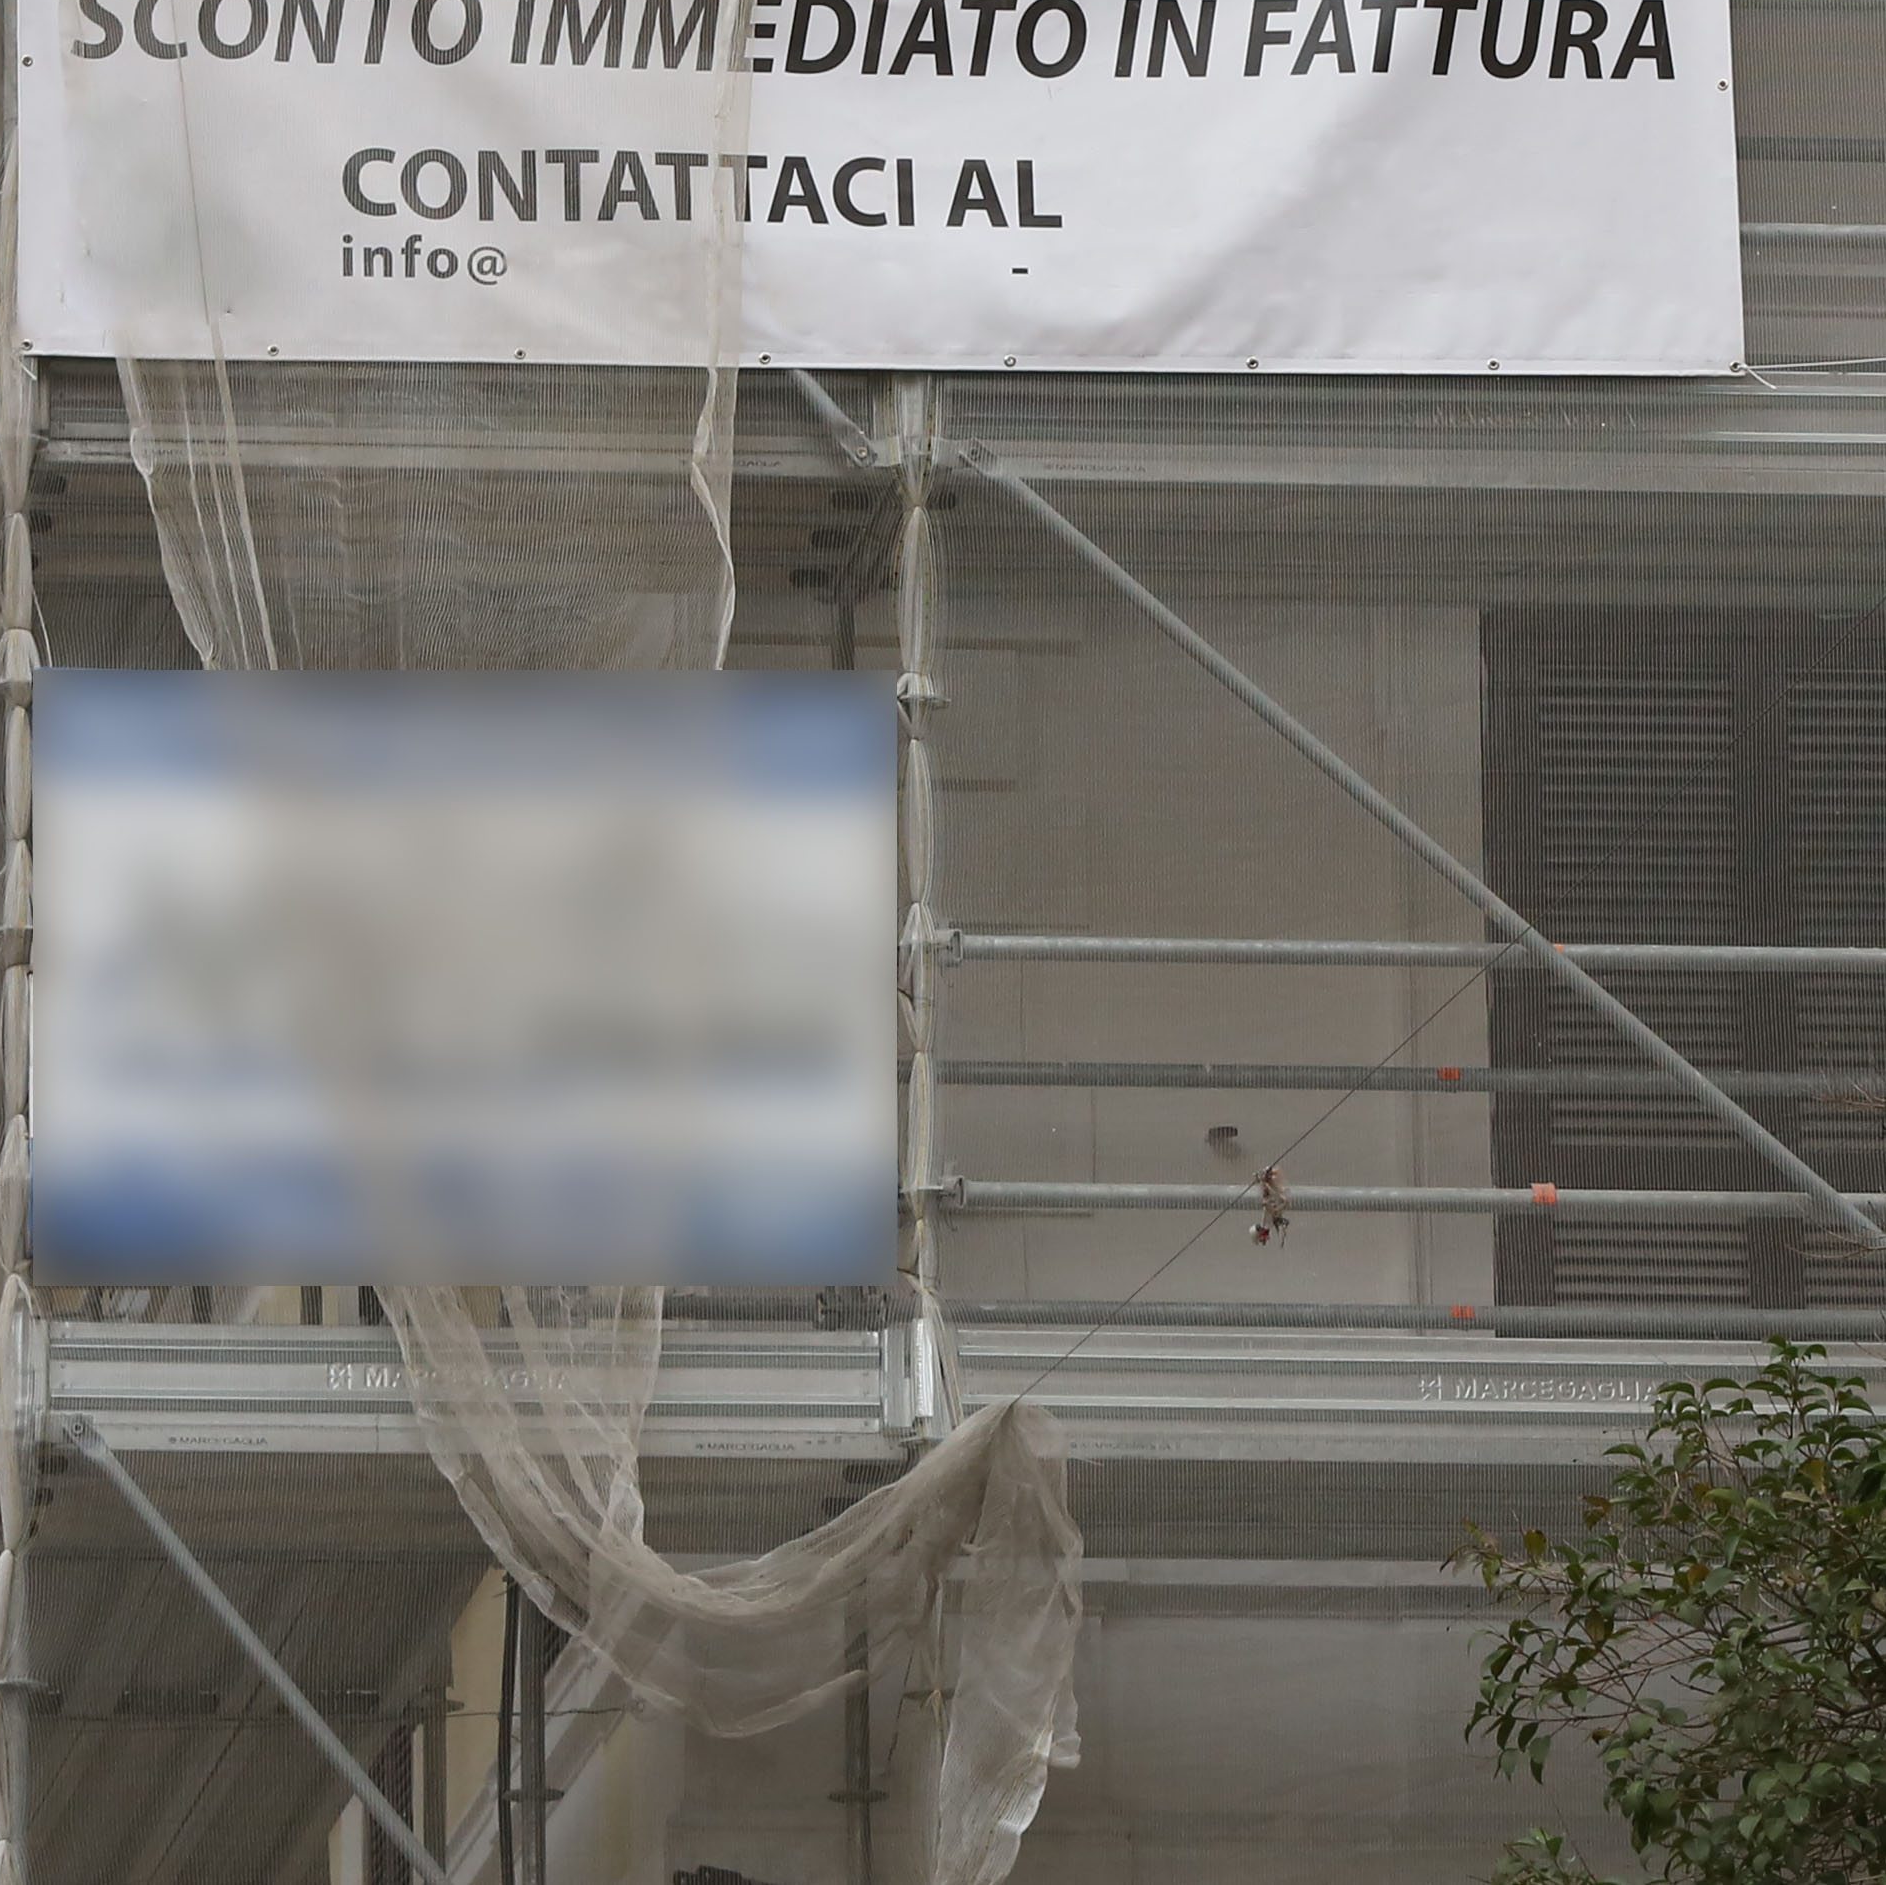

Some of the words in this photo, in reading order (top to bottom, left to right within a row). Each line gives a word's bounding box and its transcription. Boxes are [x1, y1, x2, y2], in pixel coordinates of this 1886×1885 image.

[342, 148, 915, 227] CONTATTACI
[947, 160, 1063, 228] AL
[341, 233, 508, 286] info@
[1455, 1378, 1662, 1402] MARCEGAGLIA
